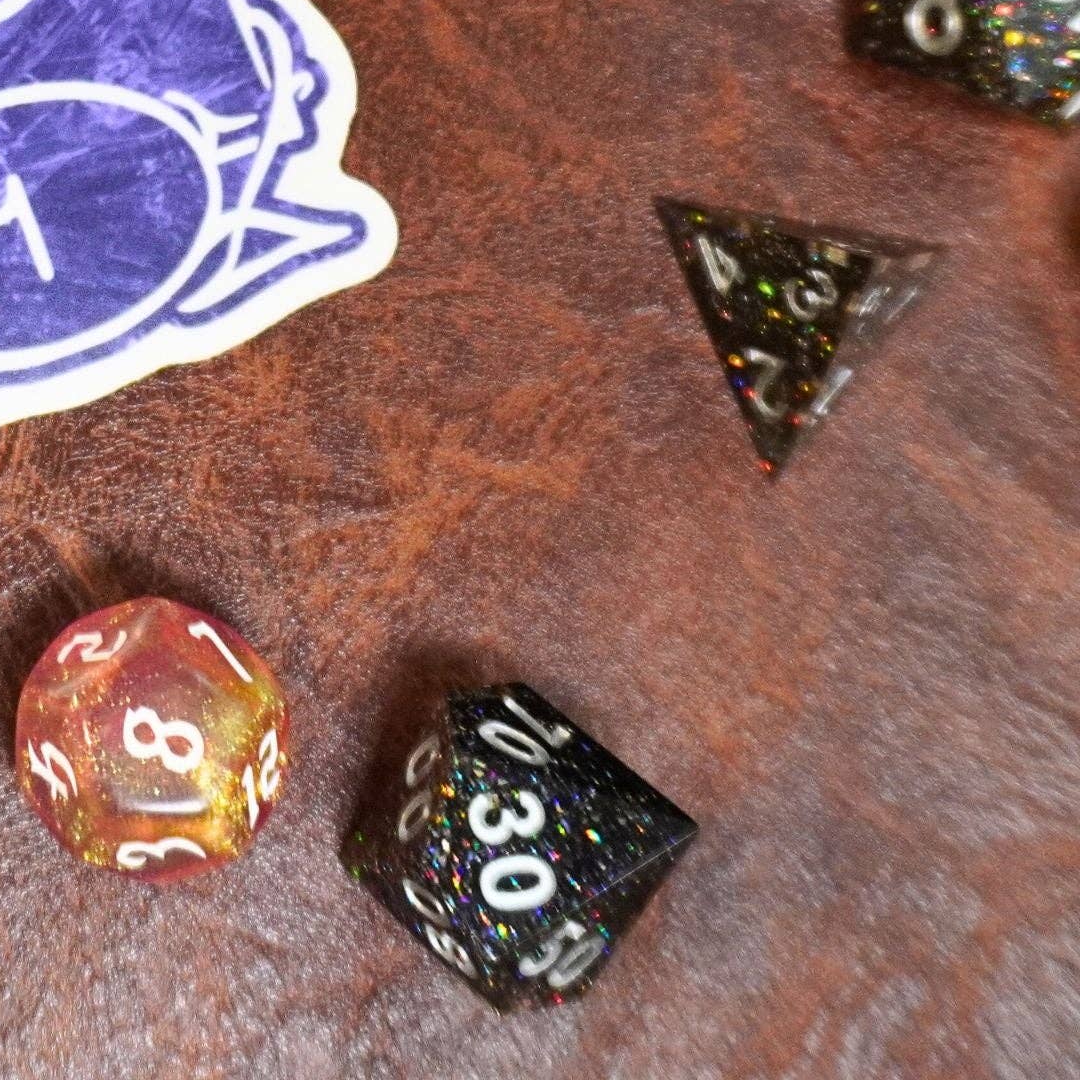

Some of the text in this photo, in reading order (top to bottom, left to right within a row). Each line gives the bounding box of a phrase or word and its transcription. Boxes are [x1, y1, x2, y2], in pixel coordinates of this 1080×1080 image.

[57, 631, 127, 663] 2
[123, 706, 204, 774] 8
[468, 790, 557, 911] 30
